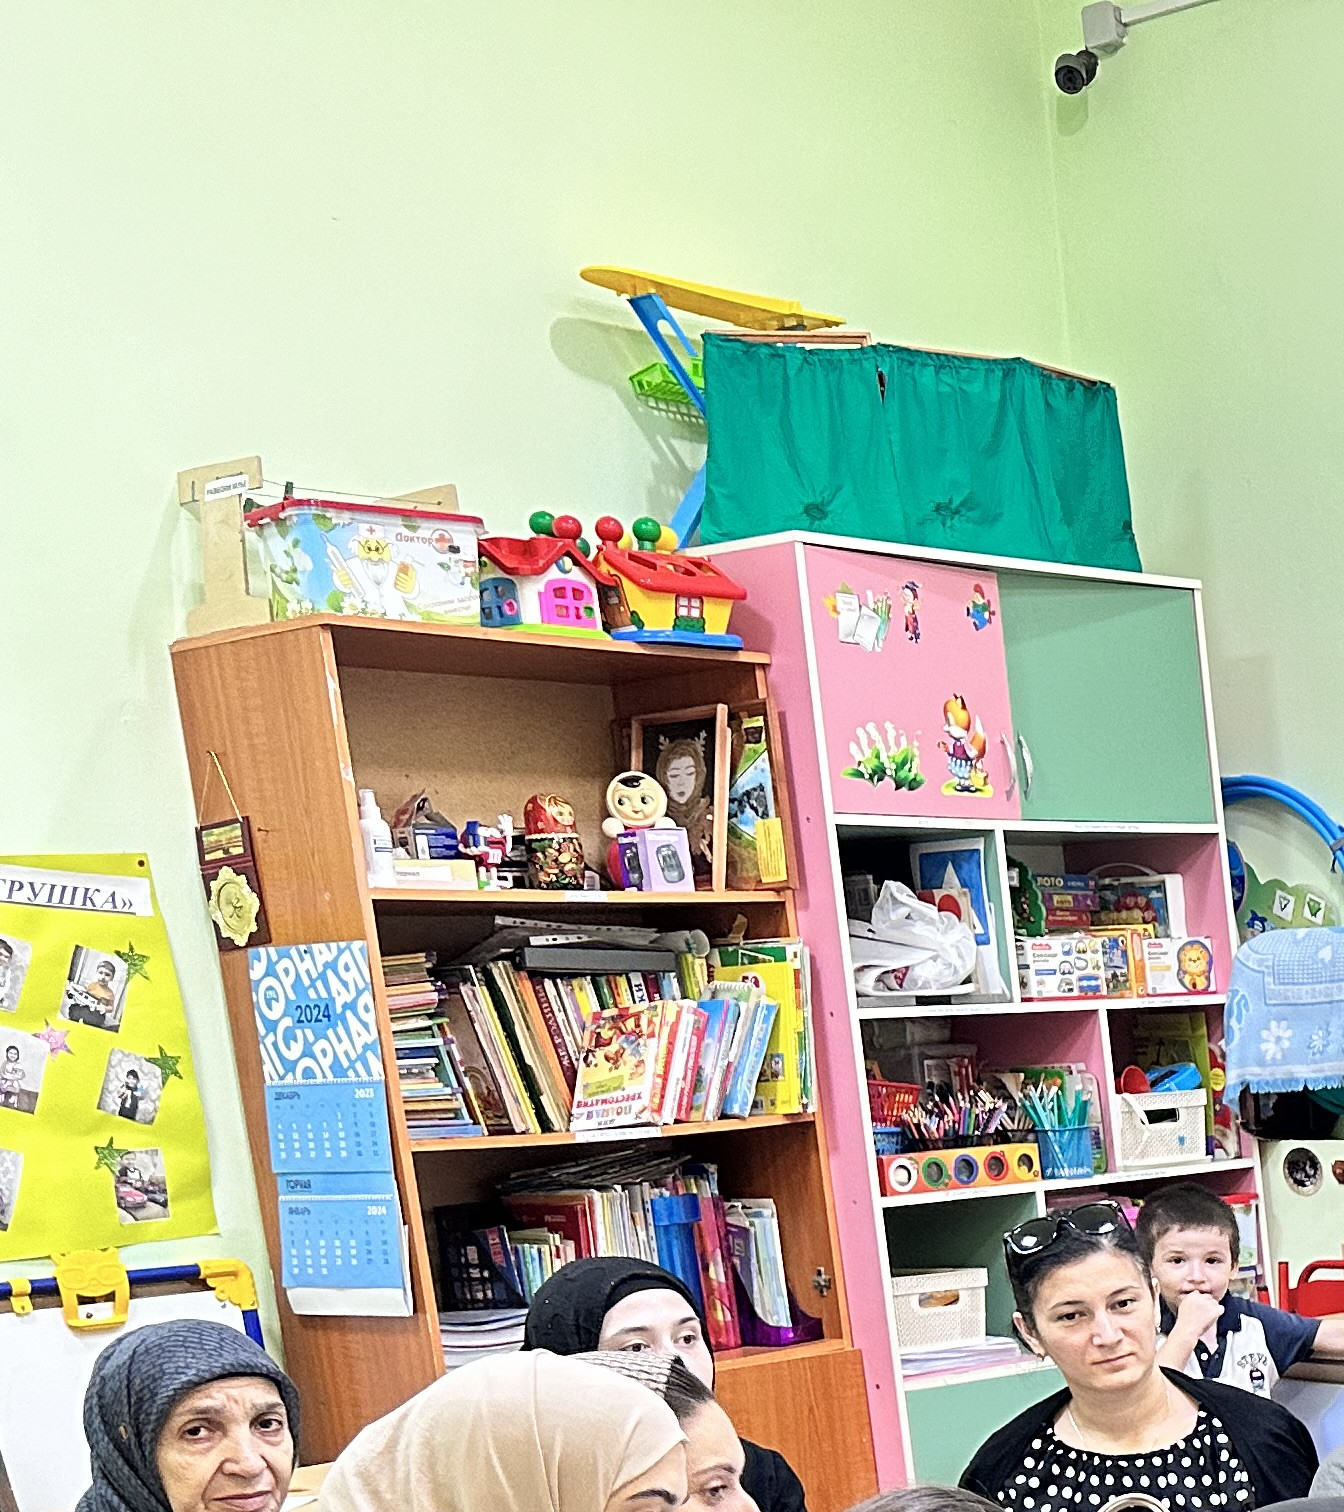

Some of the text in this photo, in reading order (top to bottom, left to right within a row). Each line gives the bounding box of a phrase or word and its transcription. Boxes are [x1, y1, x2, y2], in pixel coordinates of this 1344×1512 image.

[395, 532, 434, 547] Доктор
[295, 1003, 331, 1023] 2024
[354, 1088, 375, 1099] 2023
[366, 1205, 388, 1216] 2024
